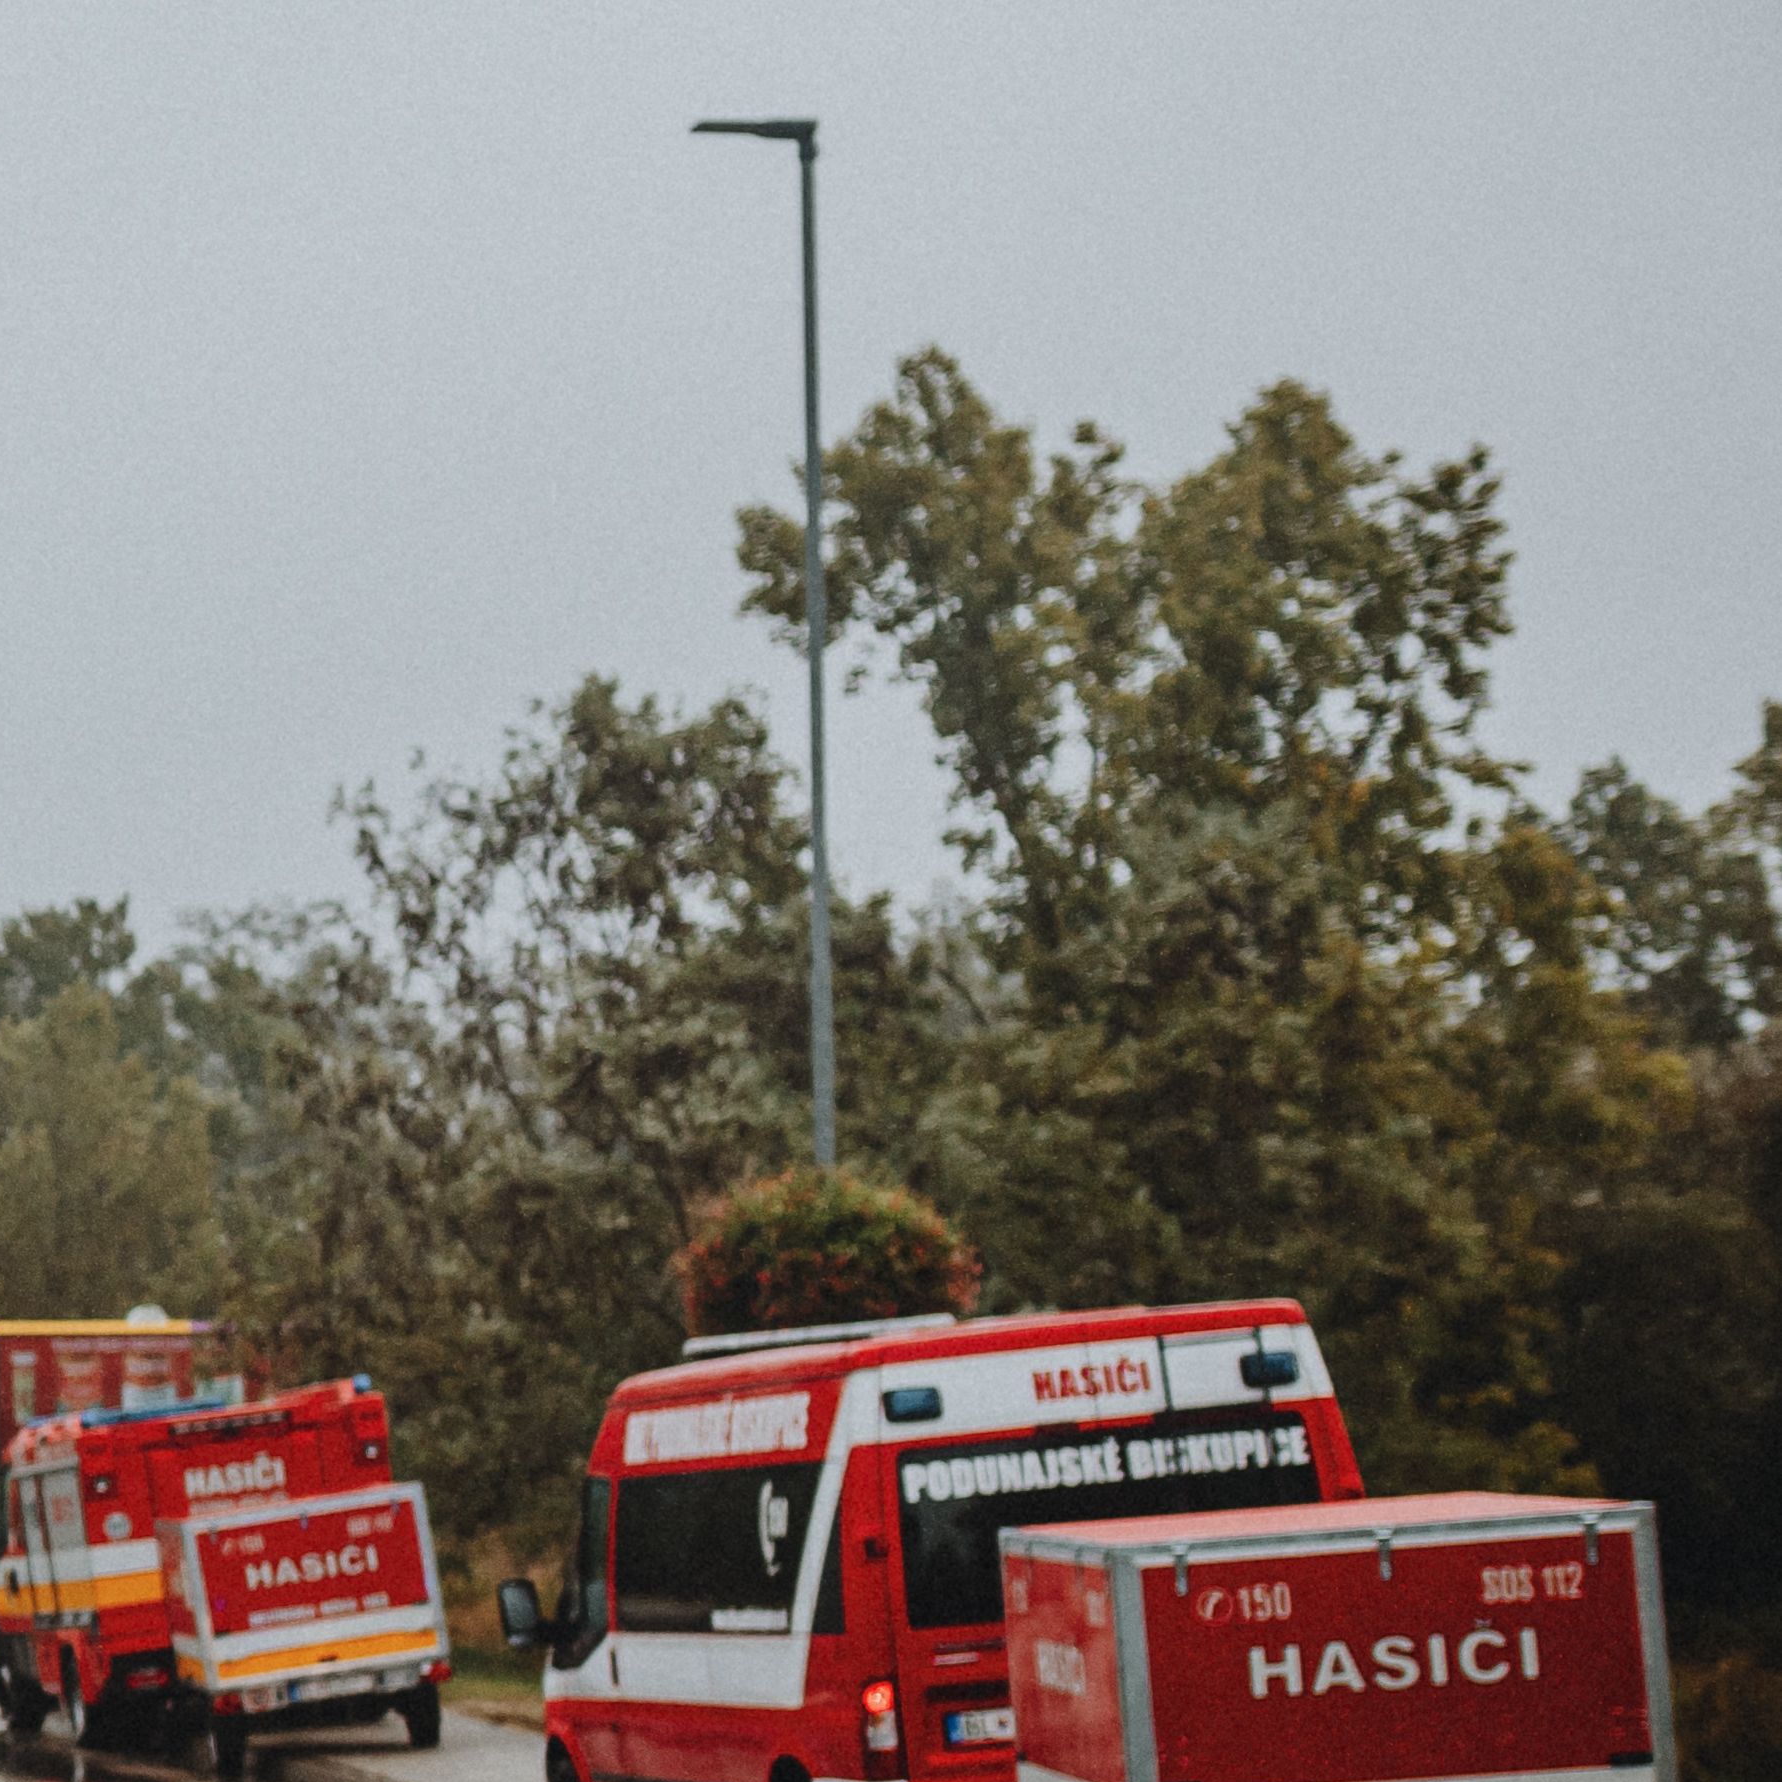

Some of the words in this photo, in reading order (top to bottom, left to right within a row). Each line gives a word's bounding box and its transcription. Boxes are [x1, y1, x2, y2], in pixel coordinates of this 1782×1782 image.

[1032, 1355, 1152, 1401] HASIČI
[901, 1436, 1125, 1503] PODUNAJSKÉ
[1238, 1581, 1292, 1621] 150
[1480, 1566, 1534, 1603] SOS
[1542, 1562, 1583, 1599] 112
